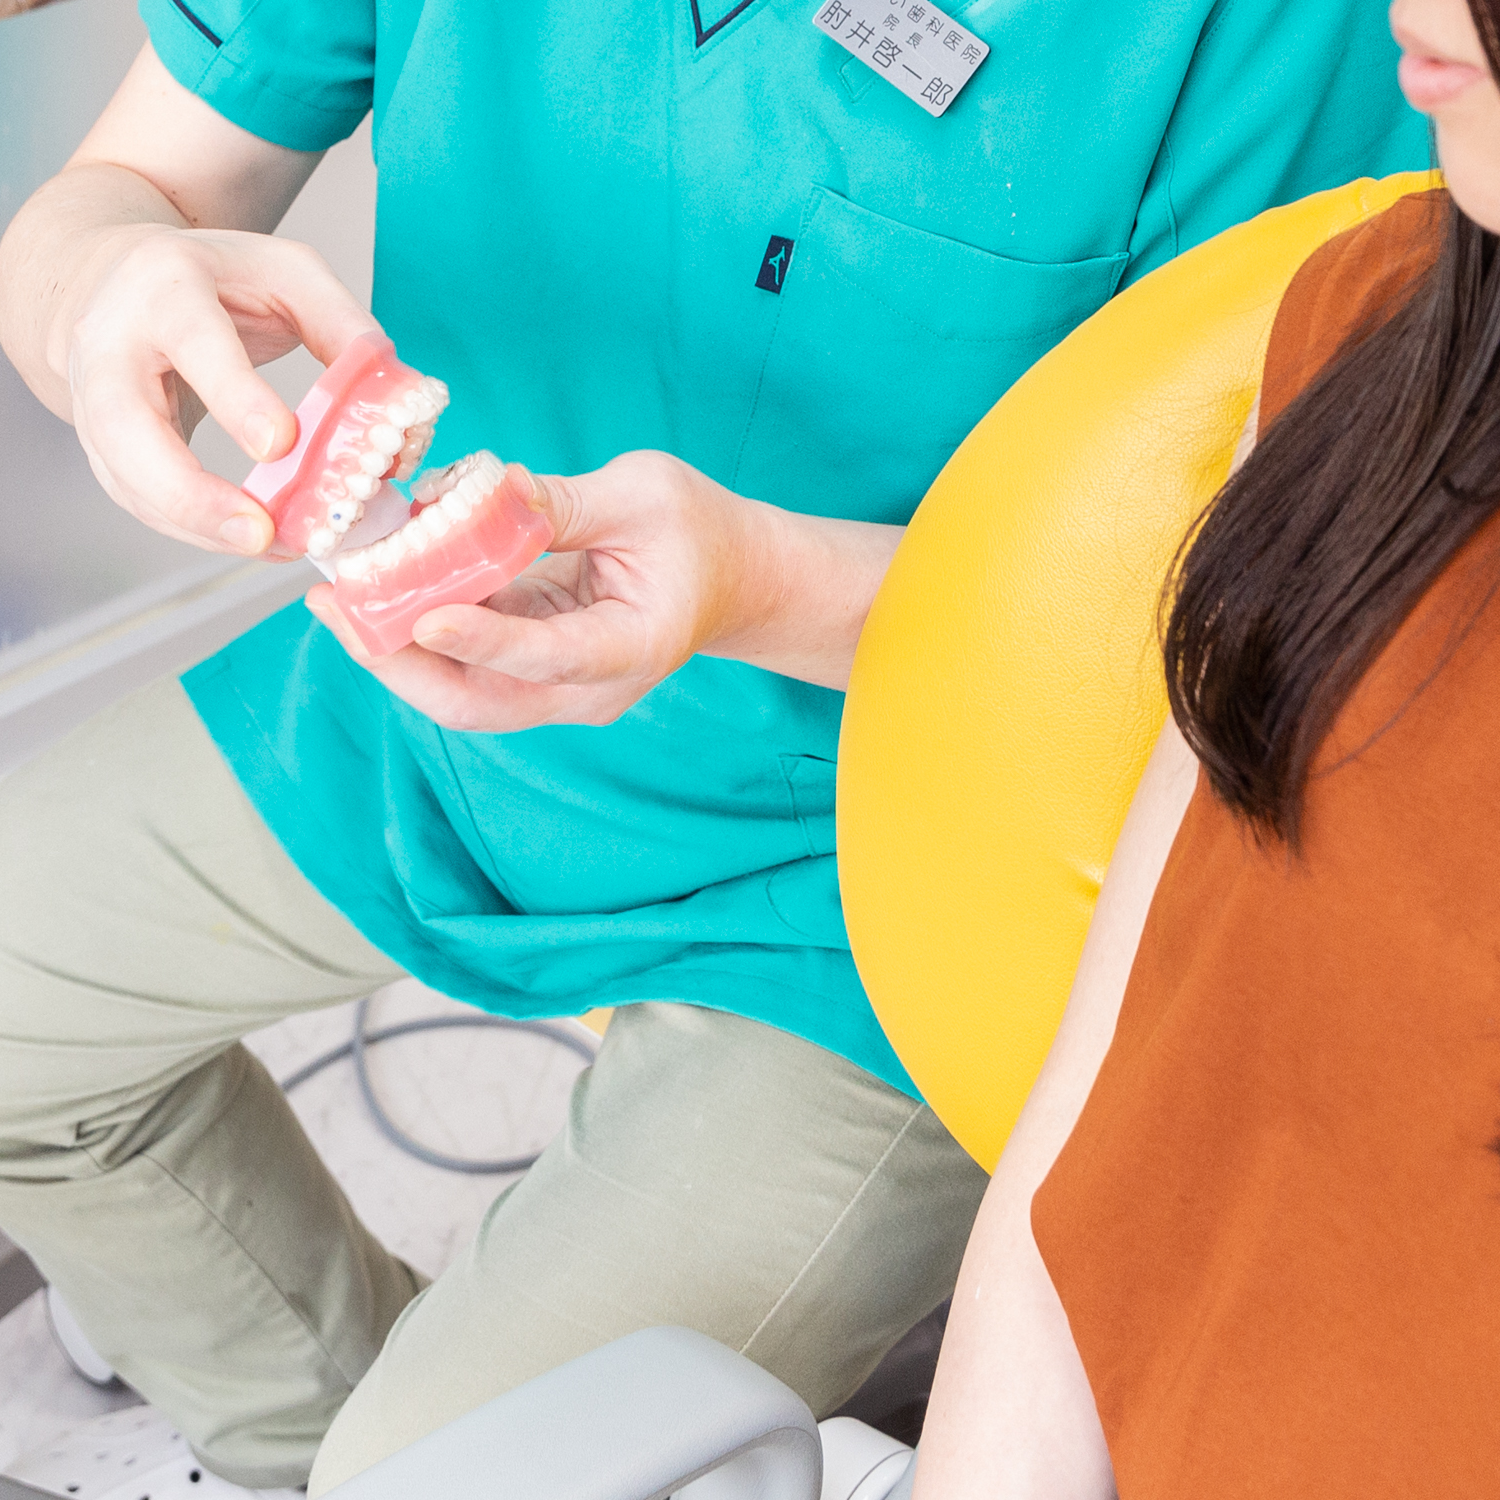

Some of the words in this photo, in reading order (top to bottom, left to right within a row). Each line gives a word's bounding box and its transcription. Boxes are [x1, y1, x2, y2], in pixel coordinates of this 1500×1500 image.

[820, 0, 954, 106] 肘井啓一郎
[883, 13, 924, 49] 院長
